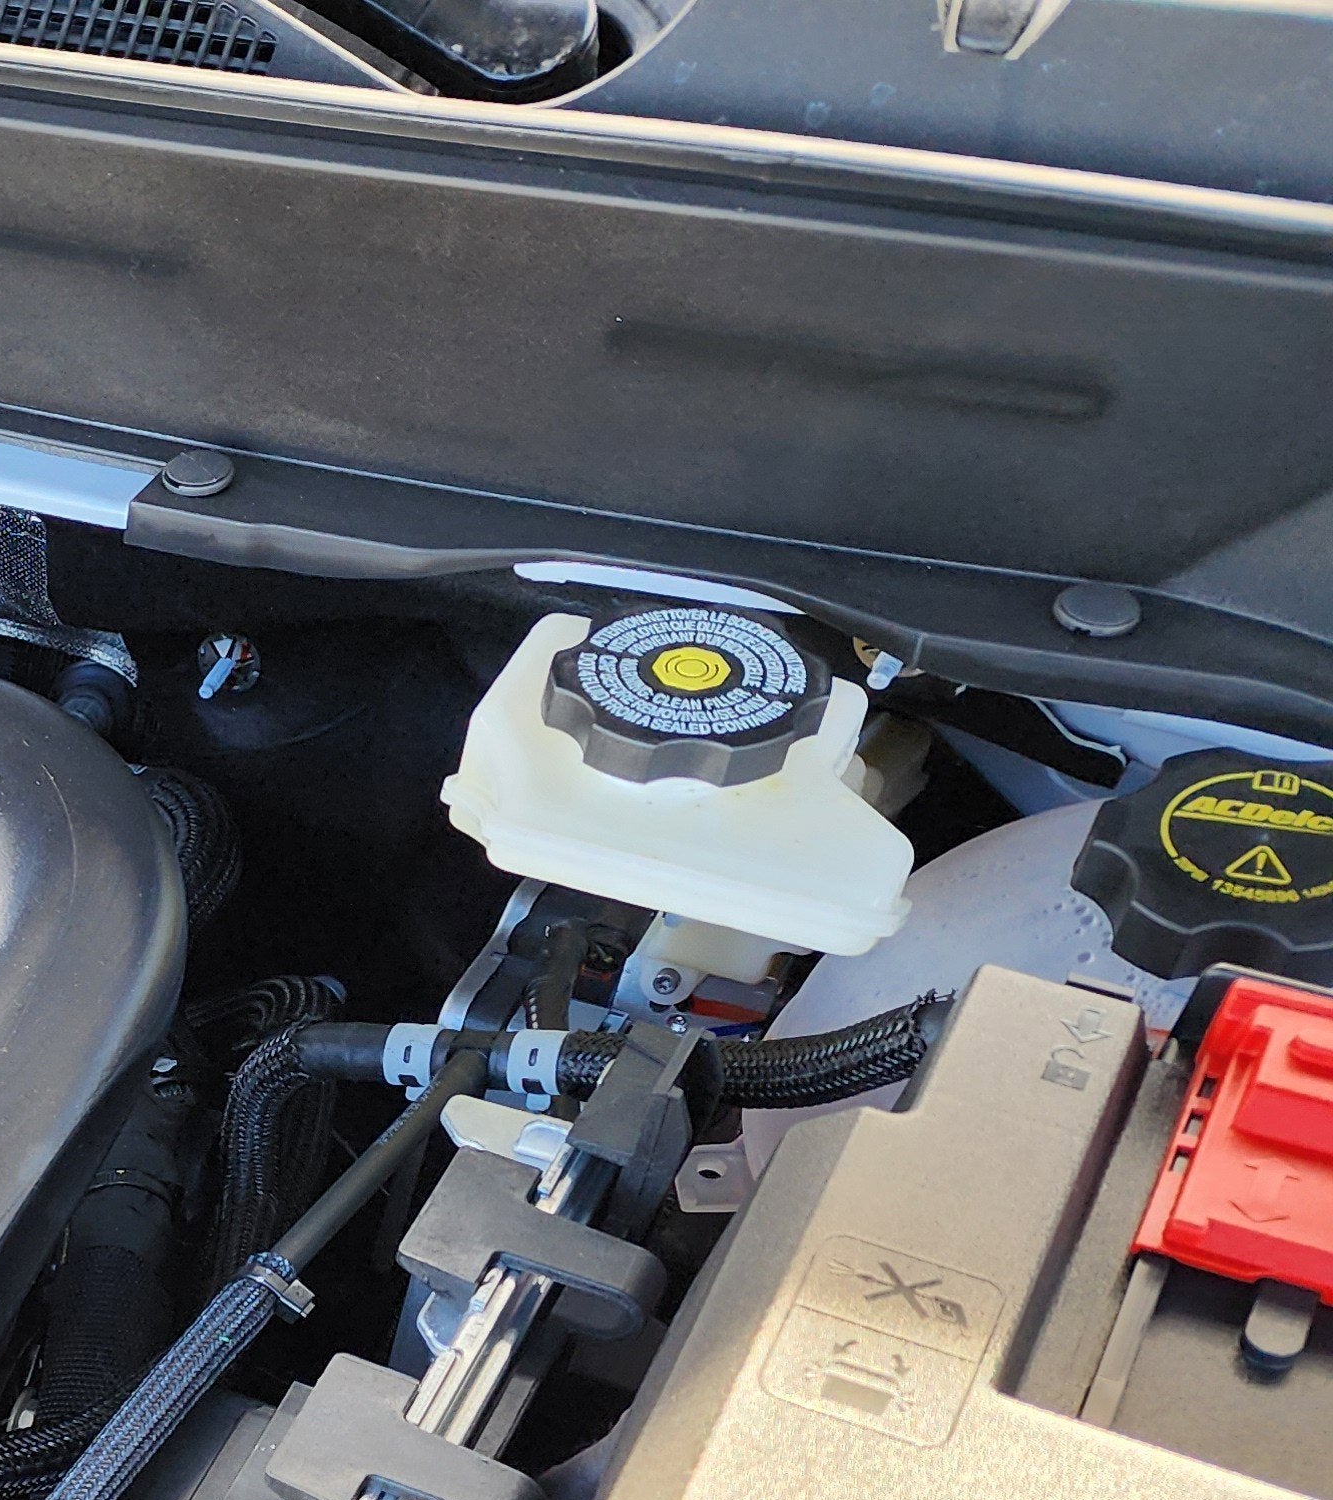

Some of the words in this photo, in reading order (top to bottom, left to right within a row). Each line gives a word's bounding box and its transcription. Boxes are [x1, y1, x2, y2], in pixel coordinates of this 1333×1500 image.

[668, 620, 697, 631] QUE
[628, 699, 710, 723] REMOVING
[707, 708, 742, 723] USE
[732, 694, 776, 718] ONLY
[647, 692, 704, 711] CLEAN
[702, 687, 756, 711] FILLER
[597, 697, 644, 723] FROM
[635, 714, 654, 727] A
[647, 718, 713, 735] SEALED
